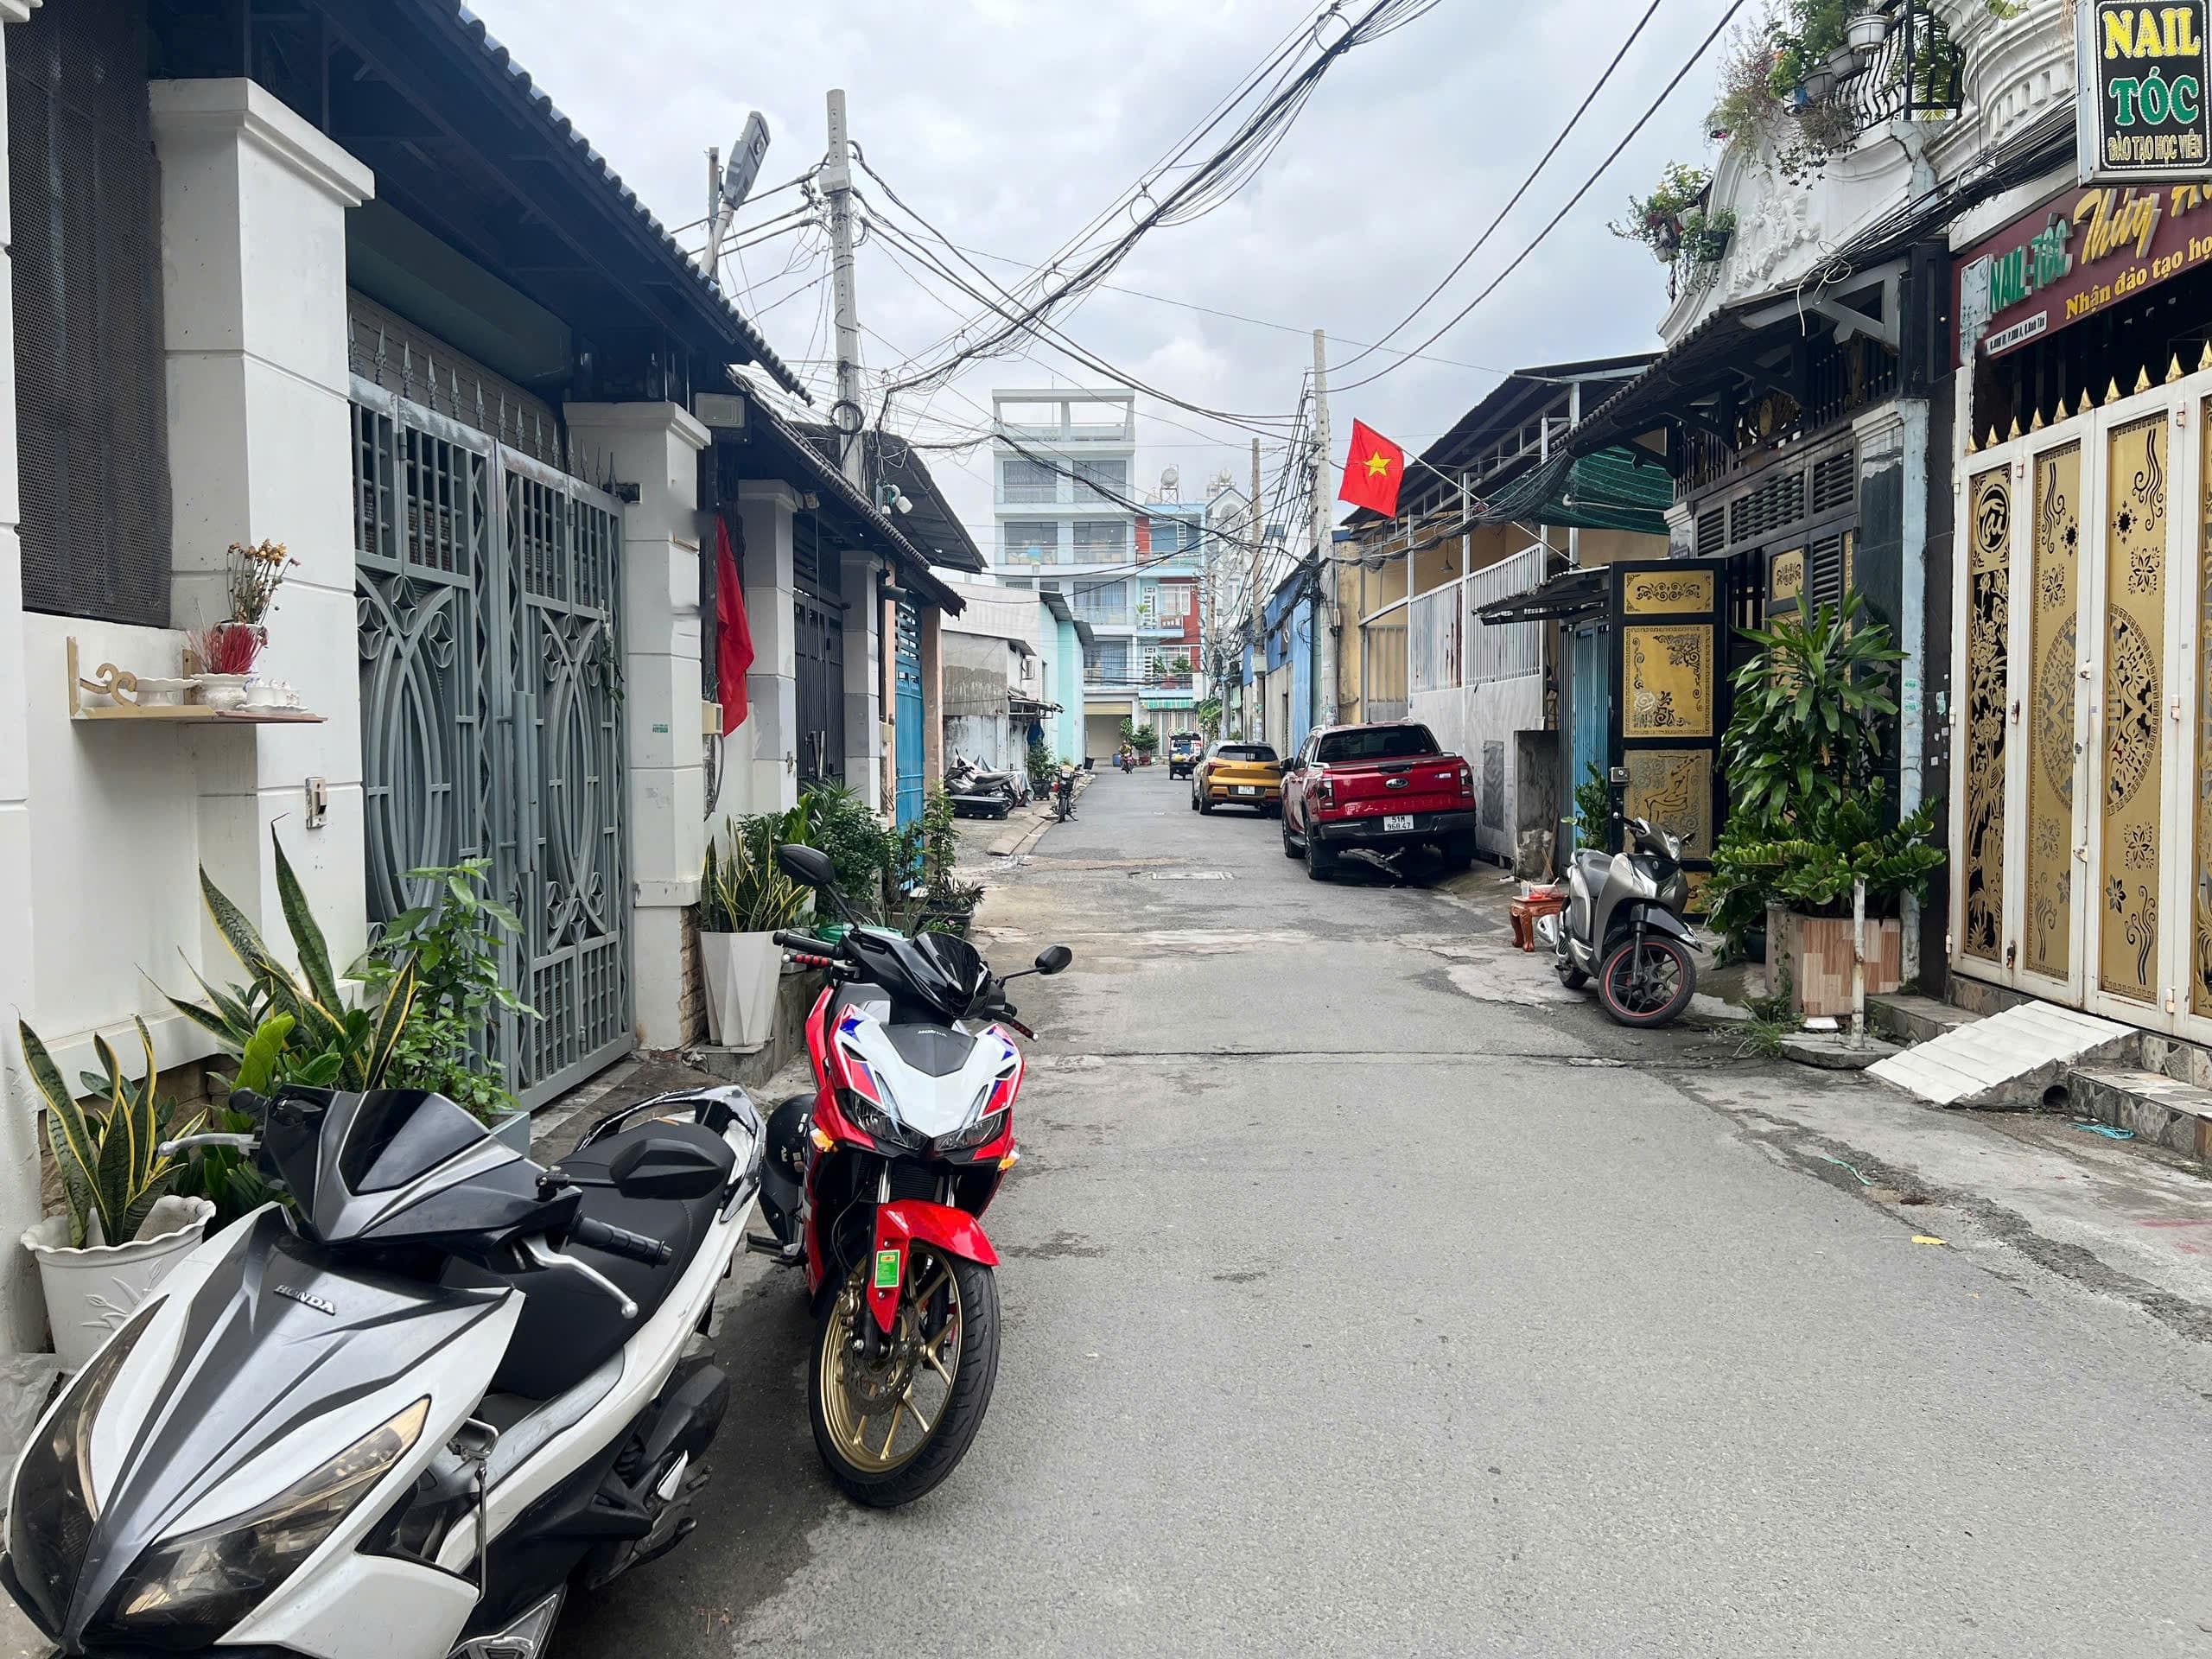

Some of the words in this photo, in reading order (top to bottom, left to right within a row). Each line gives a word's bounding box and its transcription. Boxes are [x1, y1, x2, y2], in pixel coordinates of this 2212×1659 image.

[2101, 7, 2202, 60] NAIL
[2108, 66, 2200, 126] TÓC
[2107, 130, 2133, 162] ĐÀO
[2132, 135, 2154, 166] TẠO
[2154, 134, 2177, 166] HỌC
[2065, 284, 2112, 320] Nhận
[2152, 251, 2183, 278] tạo
[274, 1284, 336, 1315] HONDA
